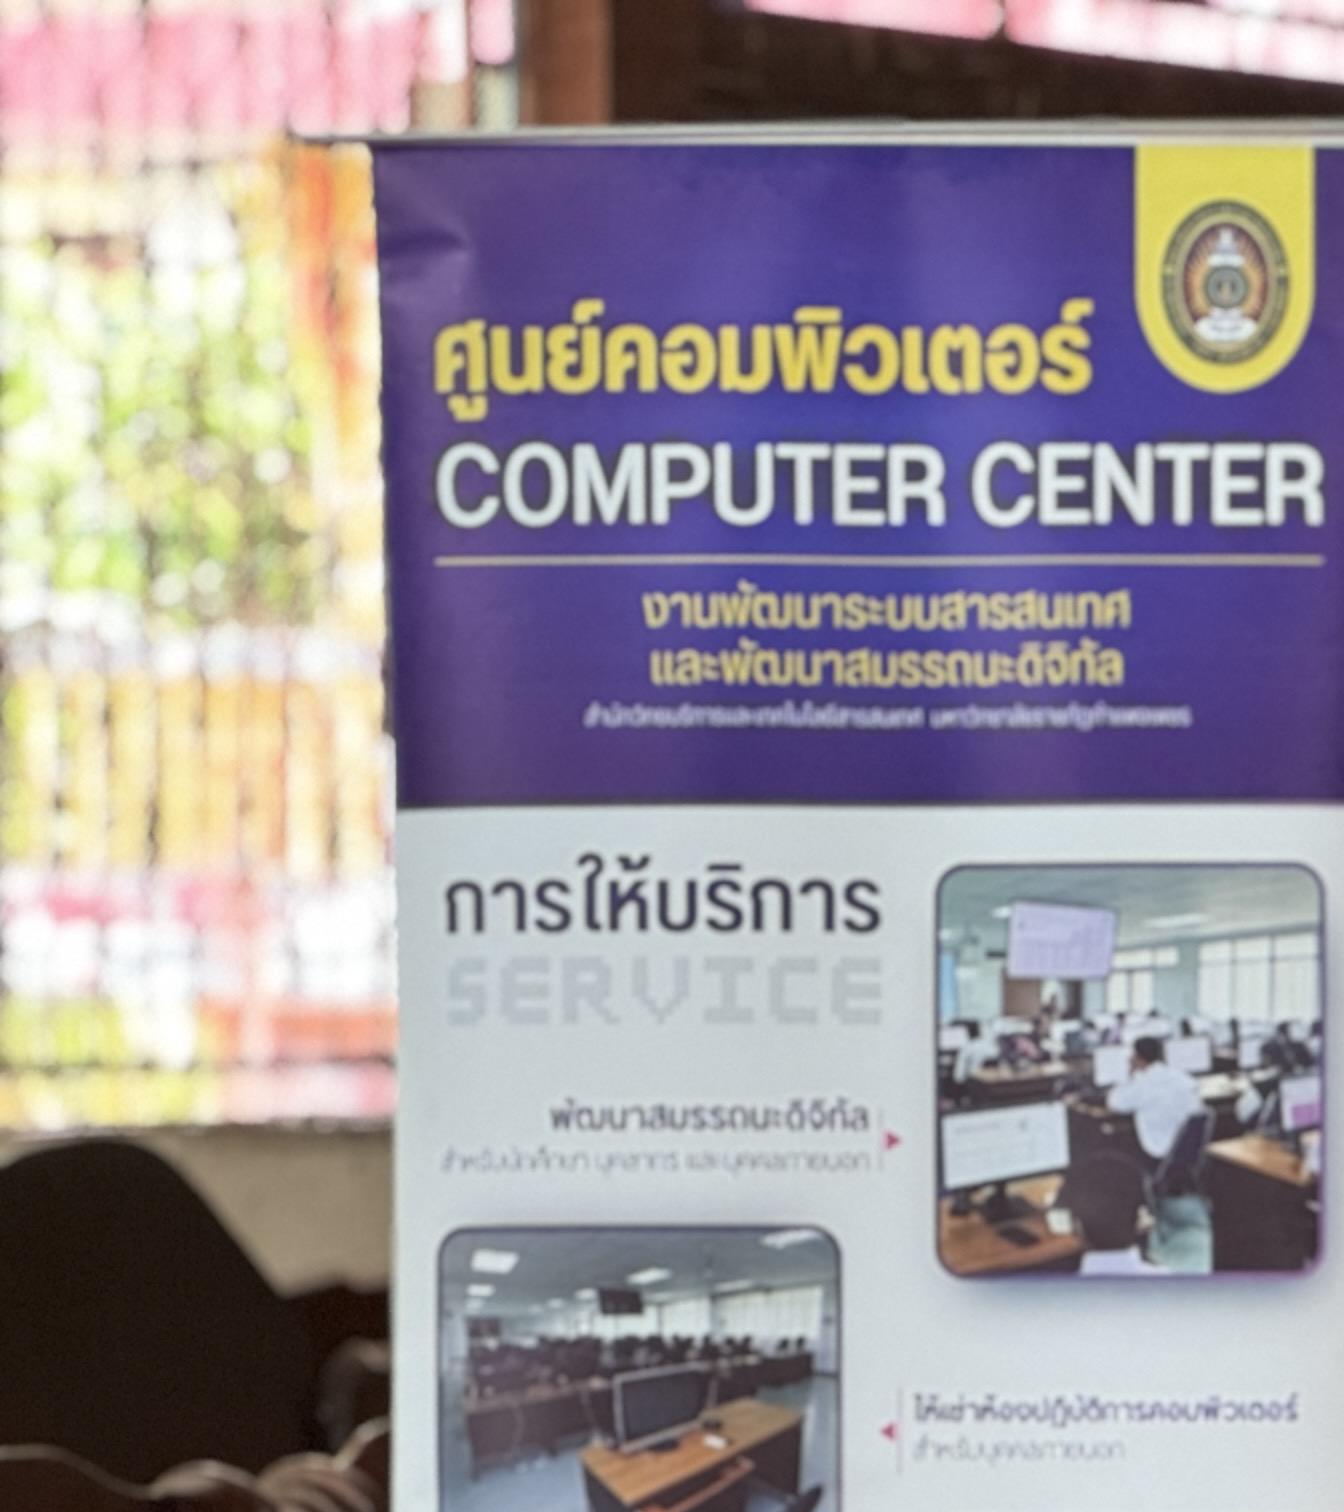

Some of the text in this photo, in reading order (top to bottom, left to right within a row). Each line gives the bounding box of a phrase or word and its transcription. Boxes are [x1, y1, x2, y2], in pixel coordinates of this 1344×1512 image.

[434, 298, 1096, 423] ศูนย์คอมพิวเตอร์
[435, 441, 1327, 528] COMPUTER CENTER
[642, 580, 1133, 631] งานพัฒนาระบบสารสนเทศ
[444, 852, 883, 936] การให้บริการ
[446, 955, 884, 1027] SERVICE
